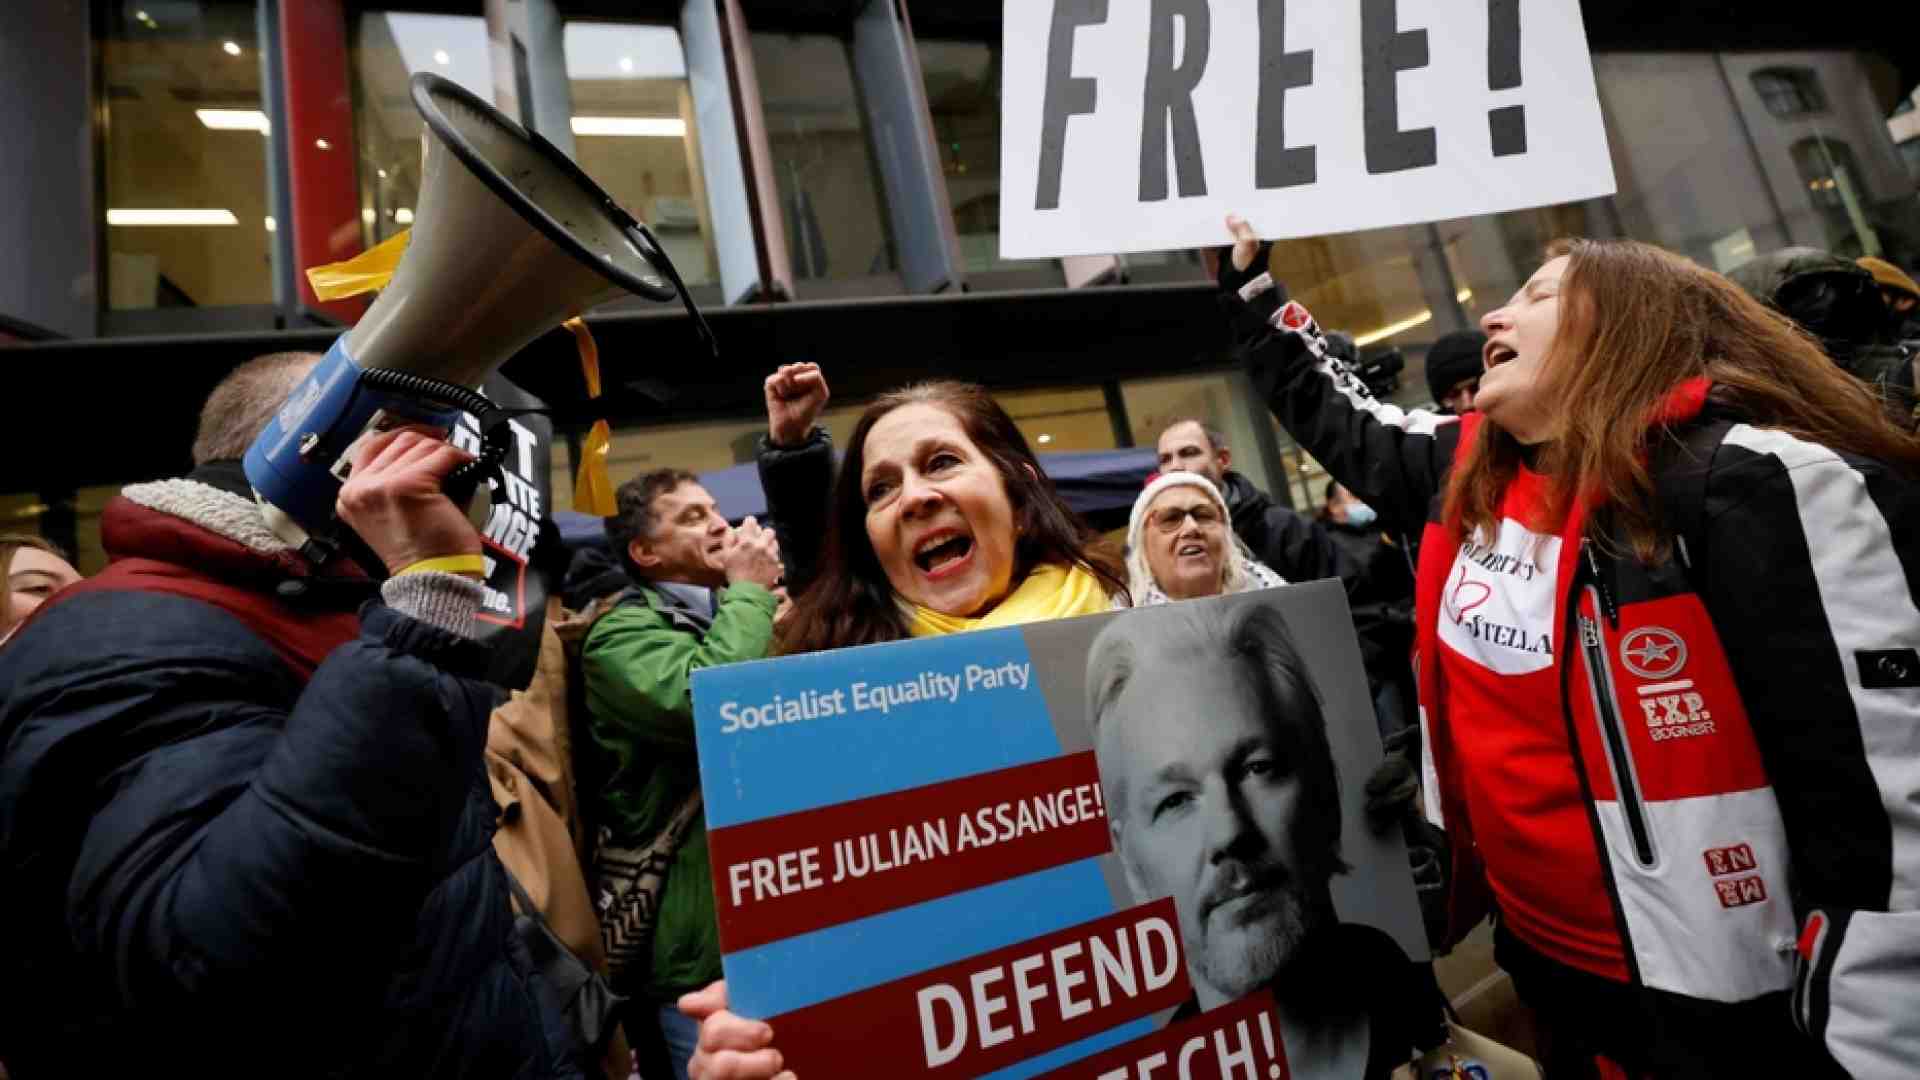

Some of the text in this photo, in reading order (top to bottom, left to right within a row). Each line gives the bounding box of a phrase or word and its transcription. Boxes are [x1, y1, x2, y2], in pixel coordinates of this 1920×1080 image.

[1034, 0, 1528, 211] FREE!
[720, 661, 1031, 734] Socialist Equality Party
[1640, 692, 1711, 728] EXP.
[728, 782, 1105, 907] FREE JULIAN ASSANGE!
[915, 916, 1180, 1068] DEFEND
